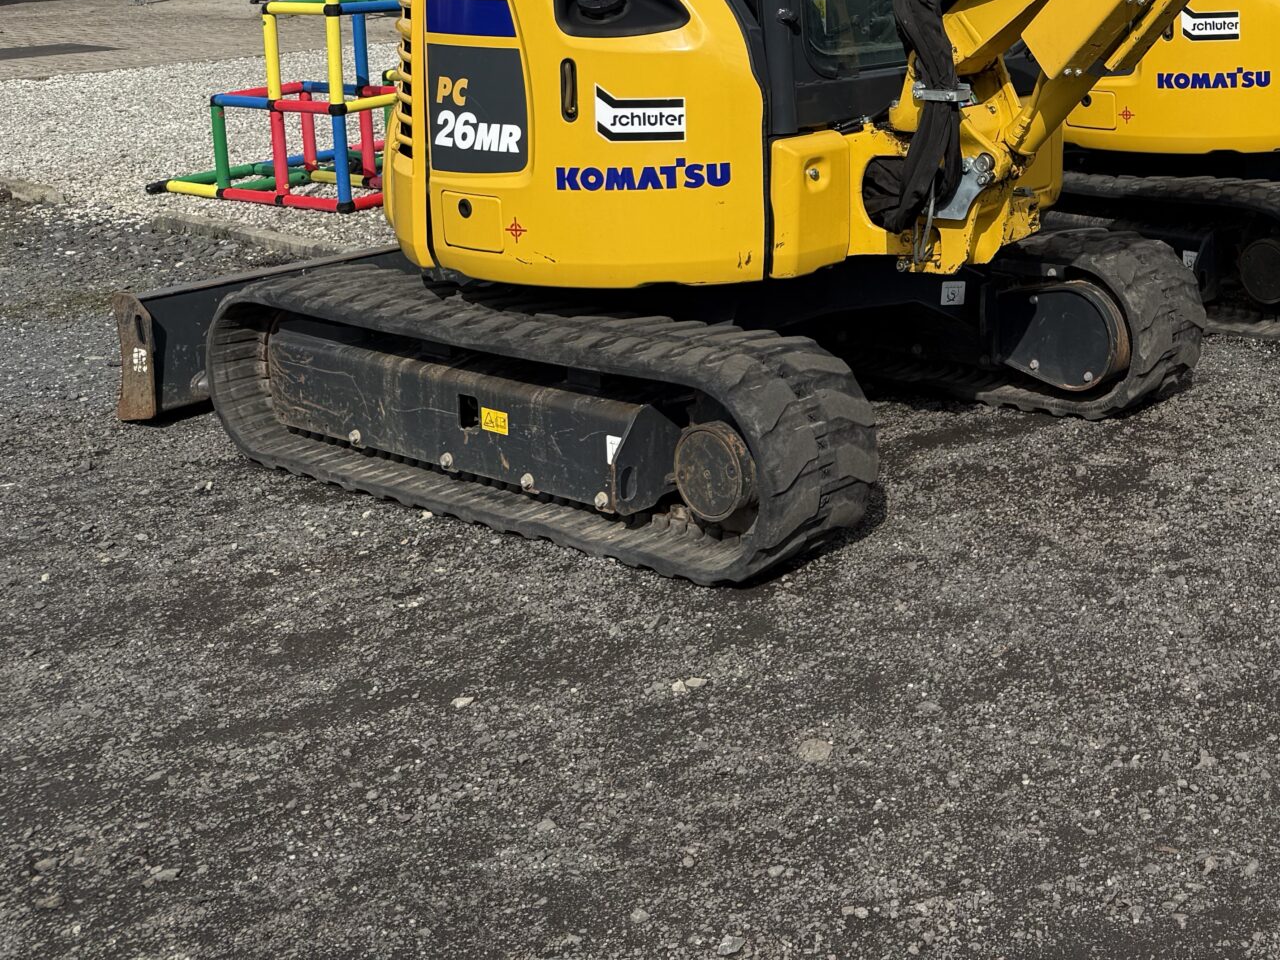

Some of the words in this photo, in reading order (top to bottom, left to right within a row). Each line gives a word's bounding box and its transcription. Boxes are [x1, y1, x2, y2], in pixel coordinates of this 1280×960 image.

[1191, 20, 1239, 31] schlüter
[1157, 67, 1271, 89] KOMATSU
[436, 76, 468, 107] PC
[434, 109, 522, 154] 26MR
[610, 111, 684, 127] schlüter
[555, 157, 732, 191] KOMATSU
